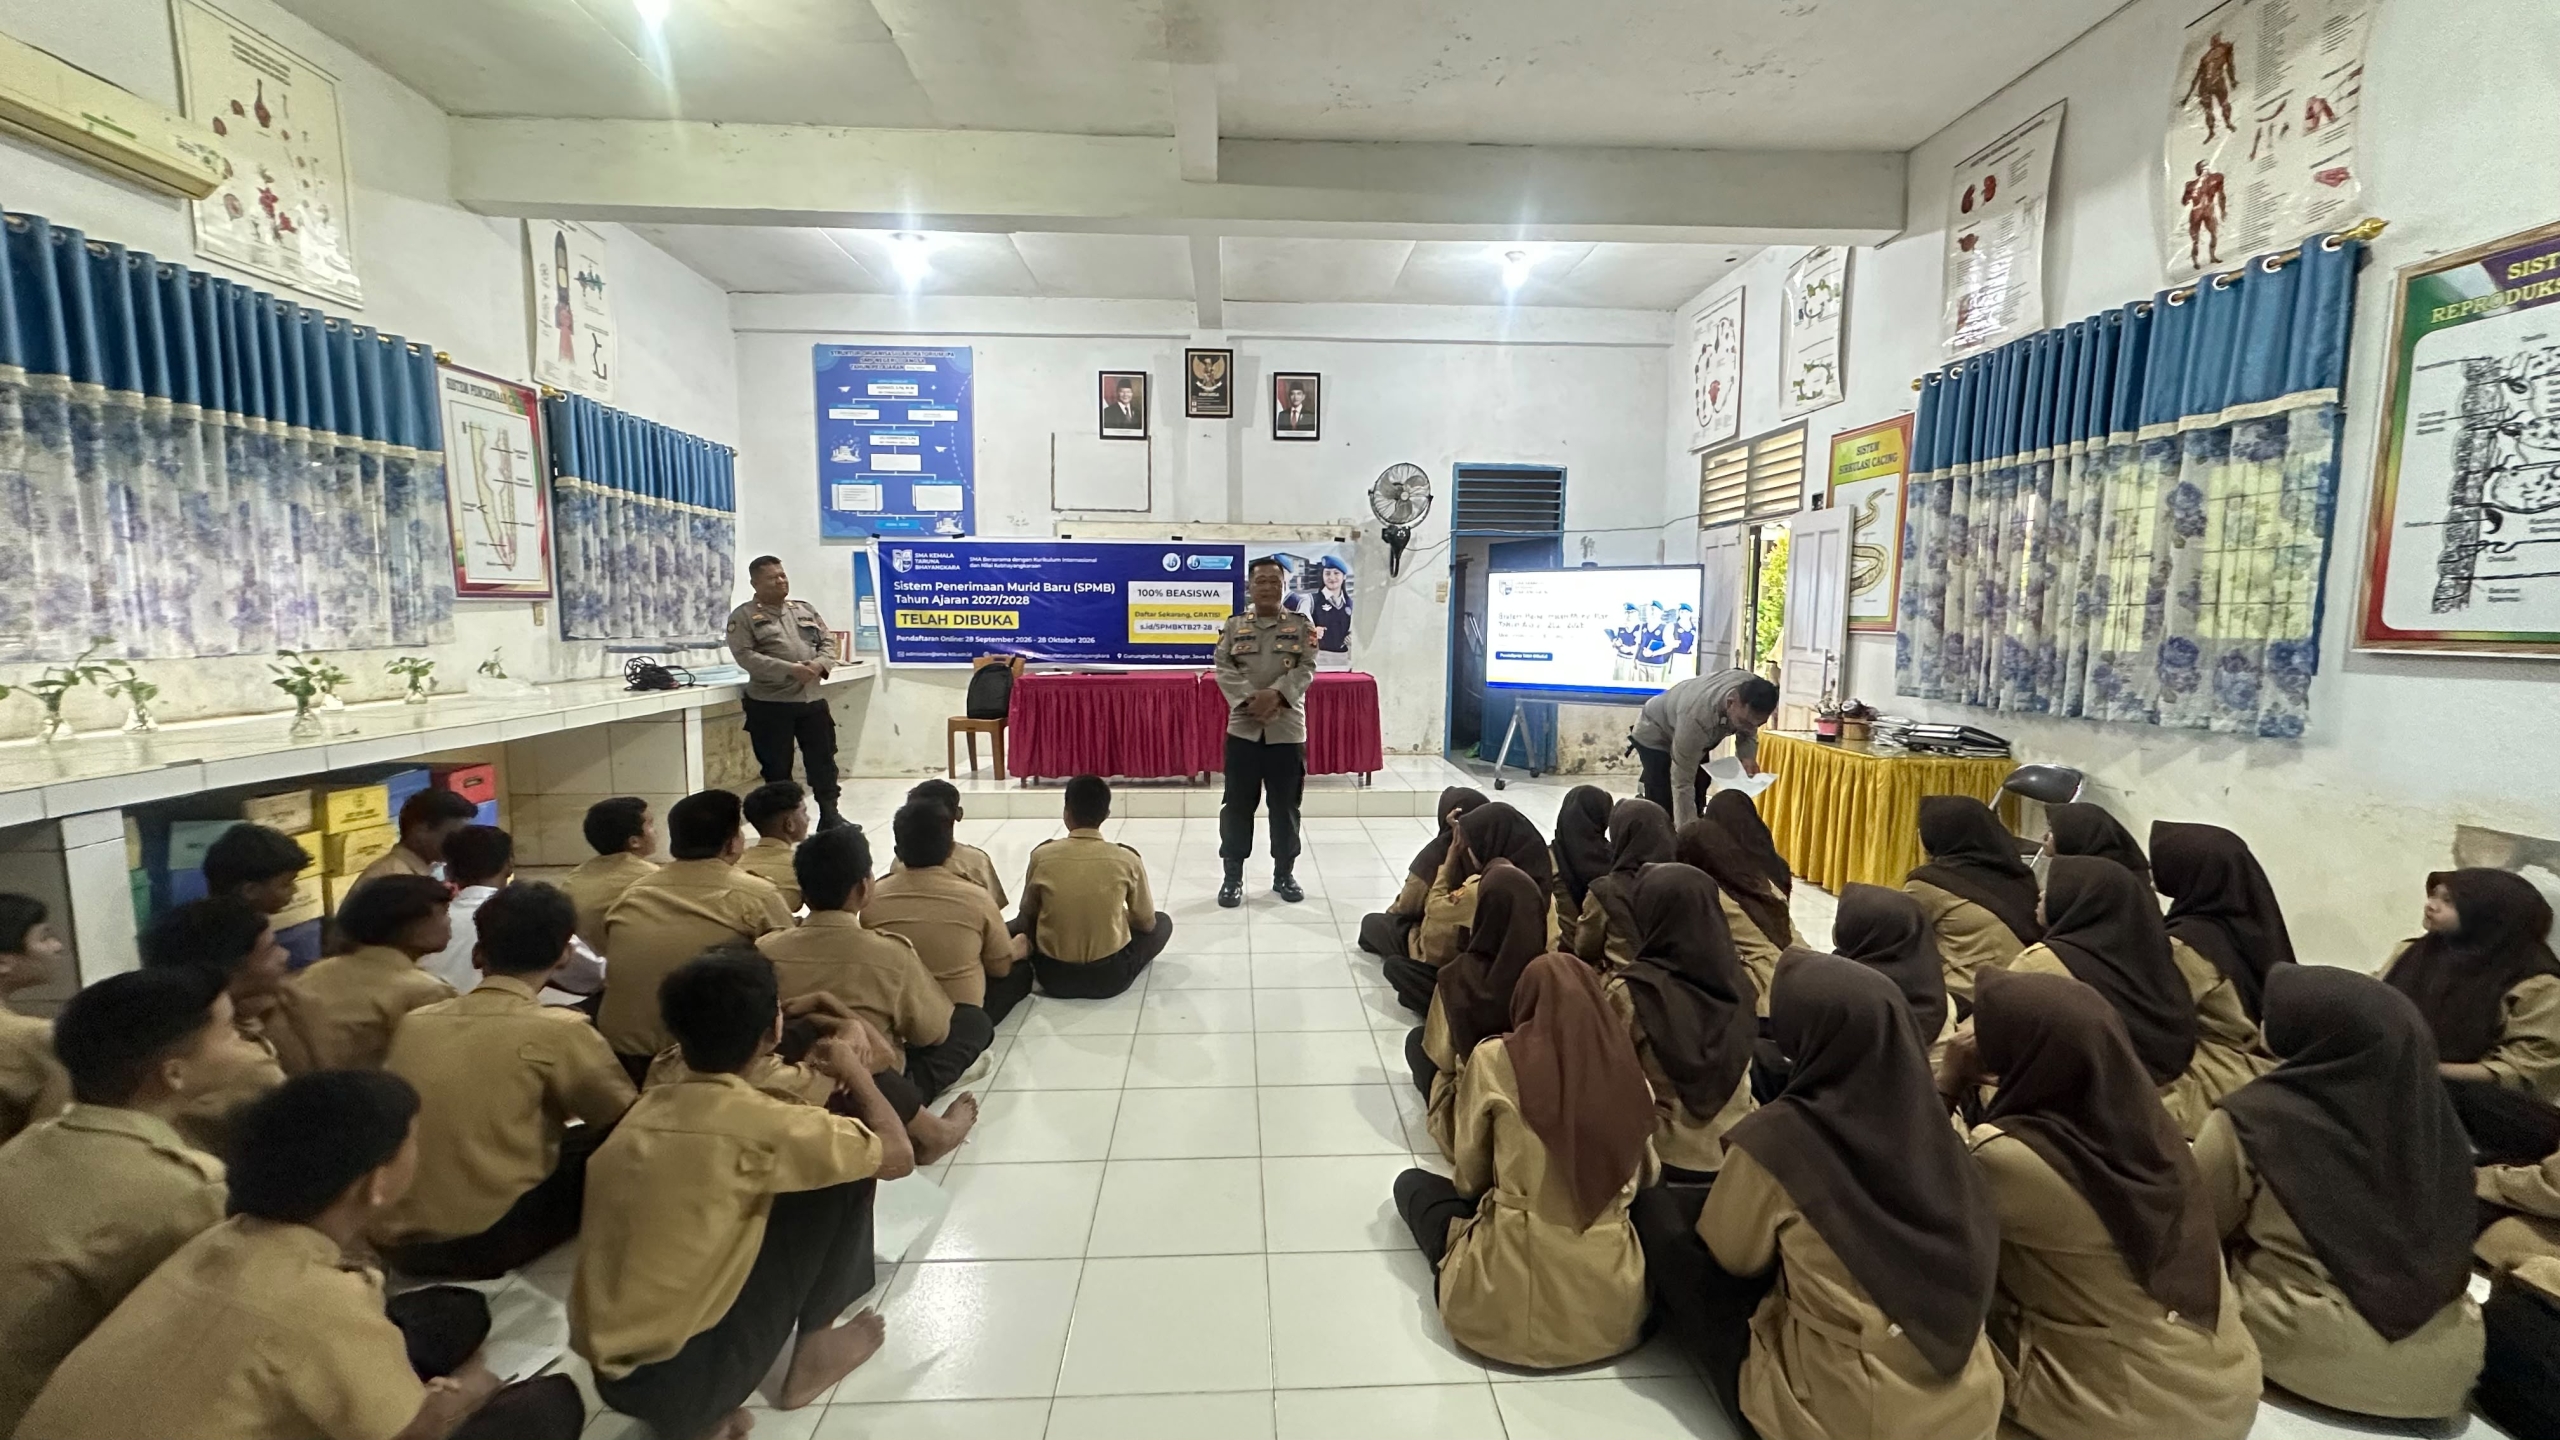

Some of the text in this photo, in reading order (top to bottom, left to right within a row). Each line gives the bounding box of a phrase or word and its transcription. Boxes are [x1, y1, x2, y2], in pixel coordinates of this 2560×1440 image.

[1856, 441, 1880, 456] SISTEM
[1872, 452, 1899, 467] CACING
[894, 581, 1116, 594] Sistem Penerimaan Murid Baru (SPMB)
[1138, 588, 1220, 598] 100% BEASISWA
[894, 594, 1030, 606] Tahun Ajaran 2027/2028
[900, 614, 1014, 626] TELAH DIBUKA
[975, 636, 1014, 645] September
